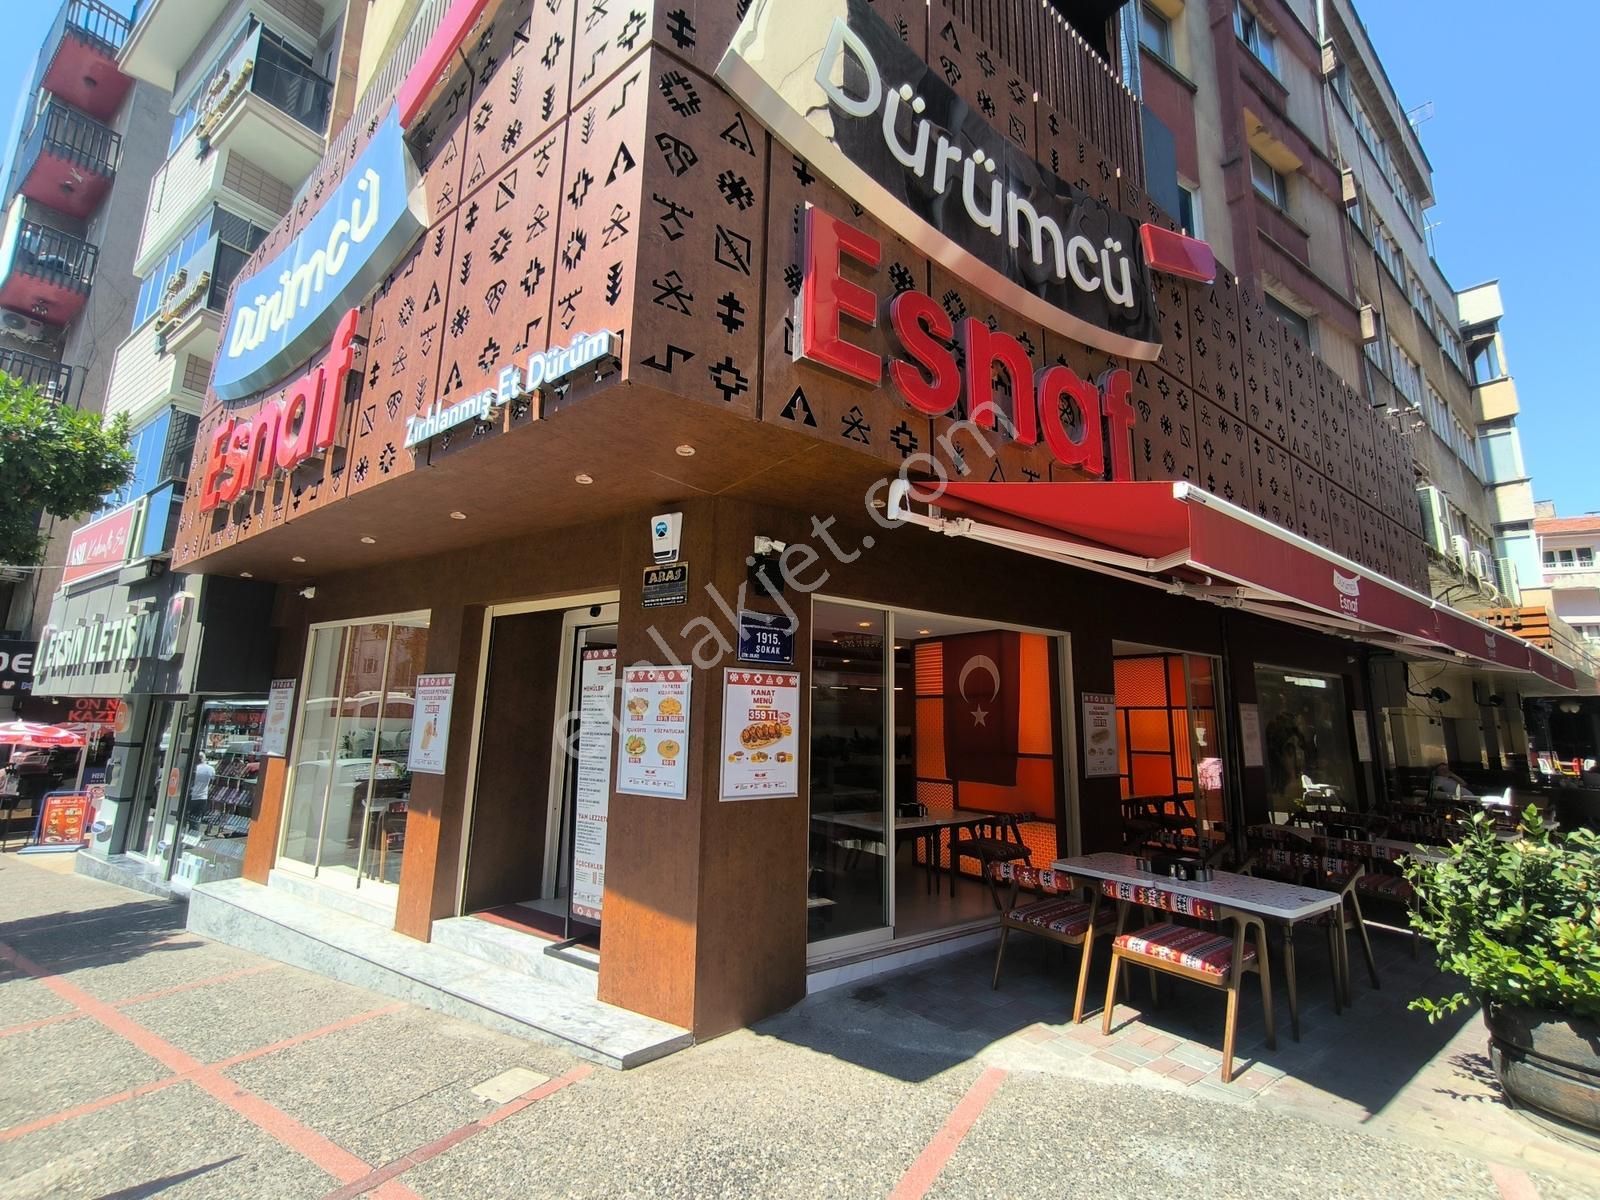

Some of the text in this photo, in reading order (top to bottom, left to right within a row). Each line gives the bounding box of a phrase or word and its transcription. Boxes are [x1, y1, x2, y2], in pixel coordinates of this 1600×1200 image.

[815, 16, 1135, 309] Dürümcü
[227, 168, 381, 359] Dürümcü
[793, 201, 1136, 482] Esnaf
[496, 363, 522, 406] Et
[525, 329, 612, 393] Dürüm
[200, 305, 360, 514] Esnaf
[755, 645, 781, 655] SOKAK
[756, 632, 781, 645] 1915.
[749, 709, 778, 721] 359 TL
[750, 688, 776, 697] KANAT
[752, 696, 773, 705] MENÜ
